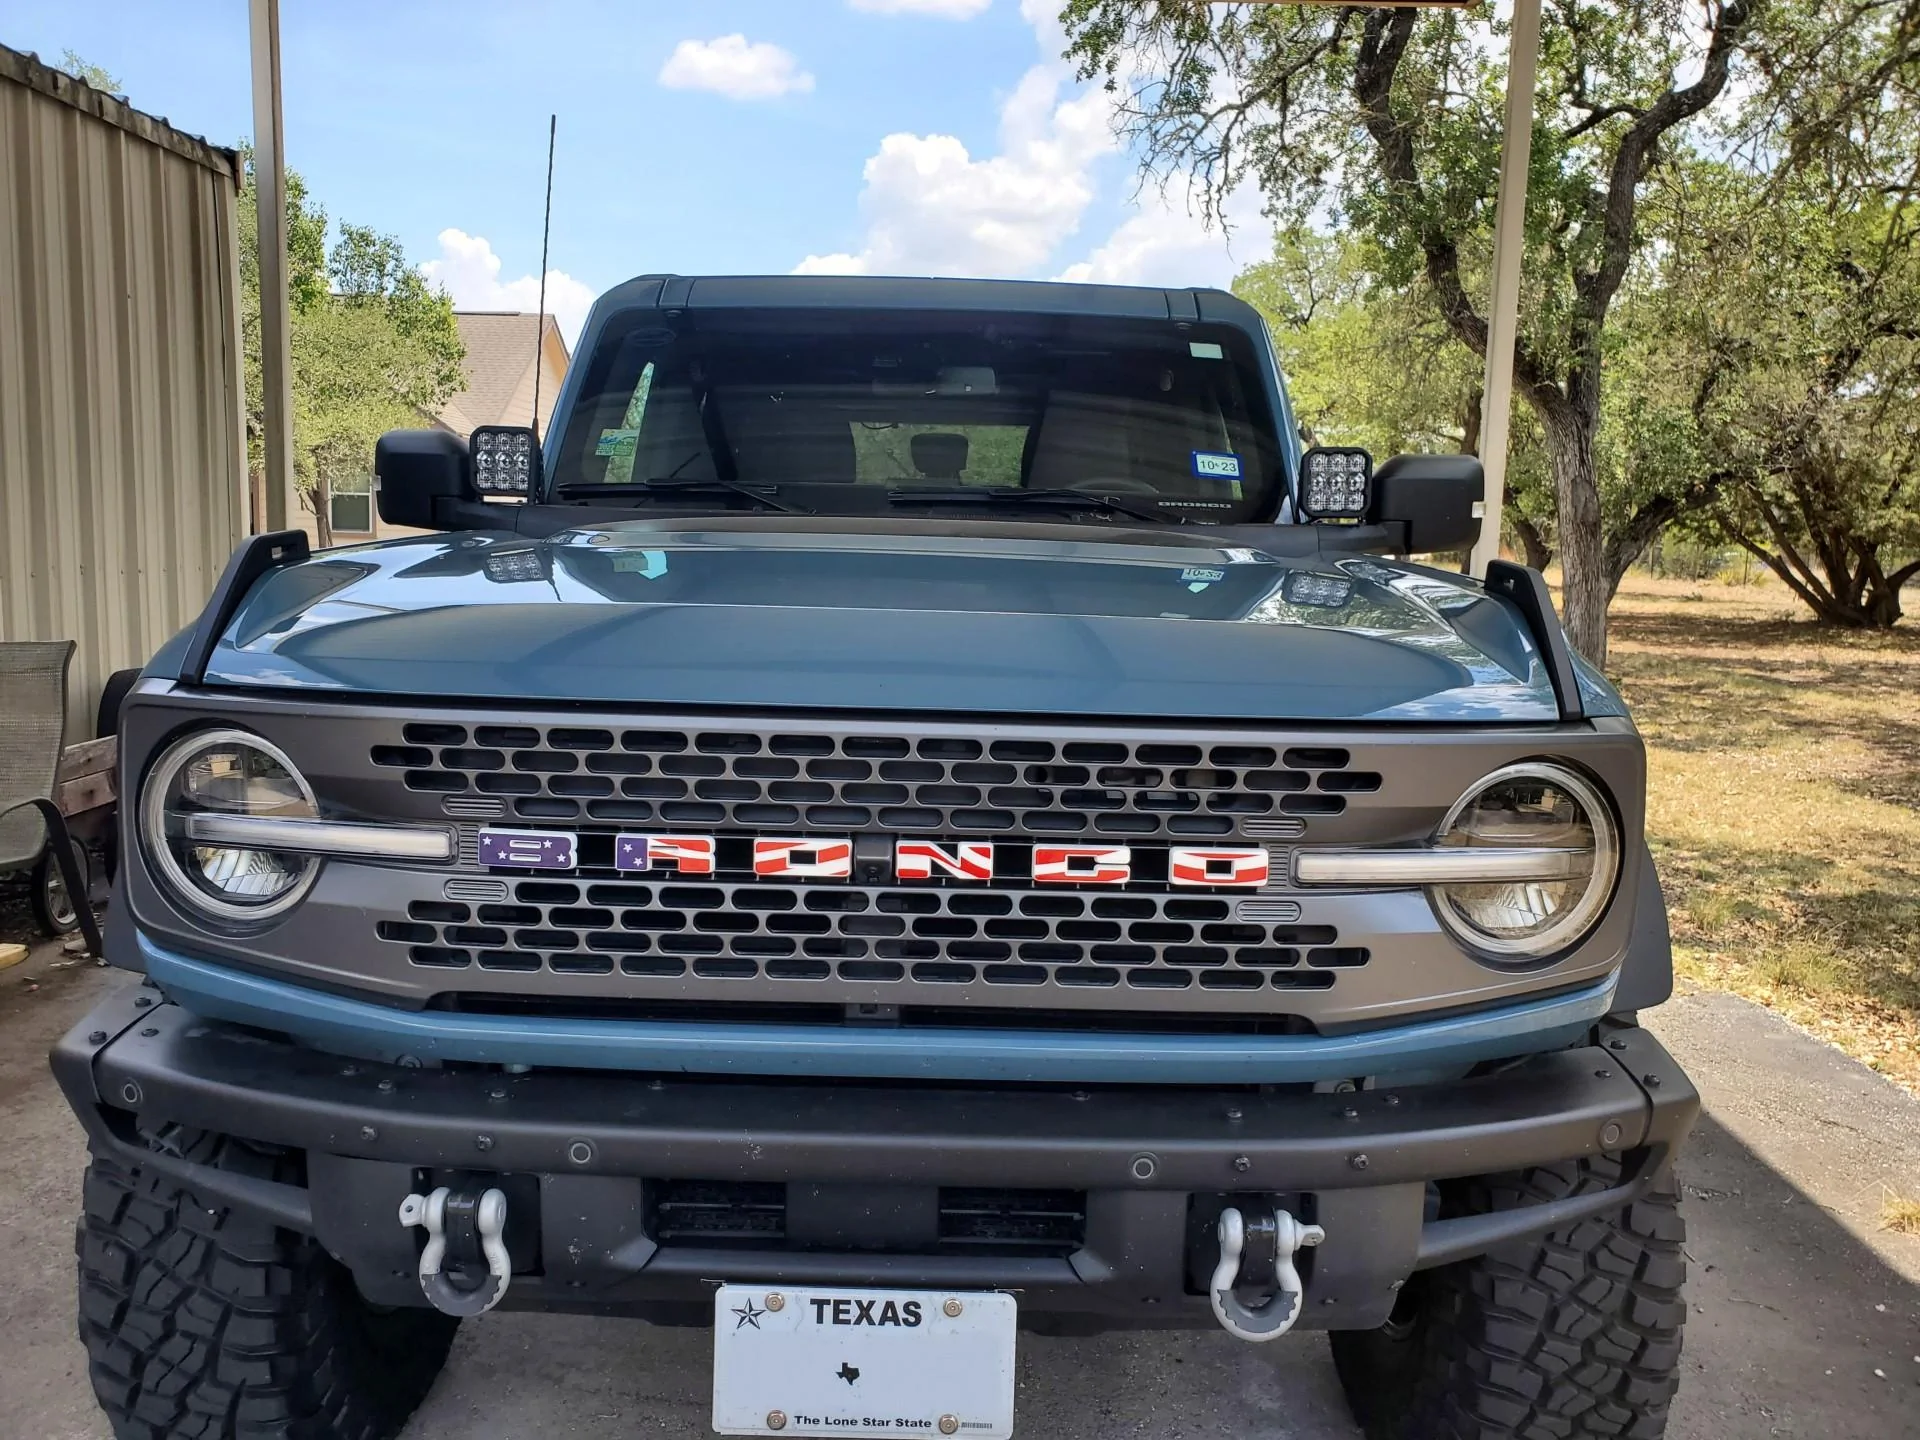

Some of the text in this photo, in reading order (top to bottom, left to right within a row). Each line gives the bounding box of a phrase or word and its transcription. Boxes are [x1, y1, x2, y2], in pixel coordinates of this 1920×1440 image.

[1200, 460, 1237, 472] 10 23
[478, 828, 1269, 887] BRONCO
[810, 1298, 922, 1327] TEXAS
[794, 1416, 932, 1428] The Lone Star State
